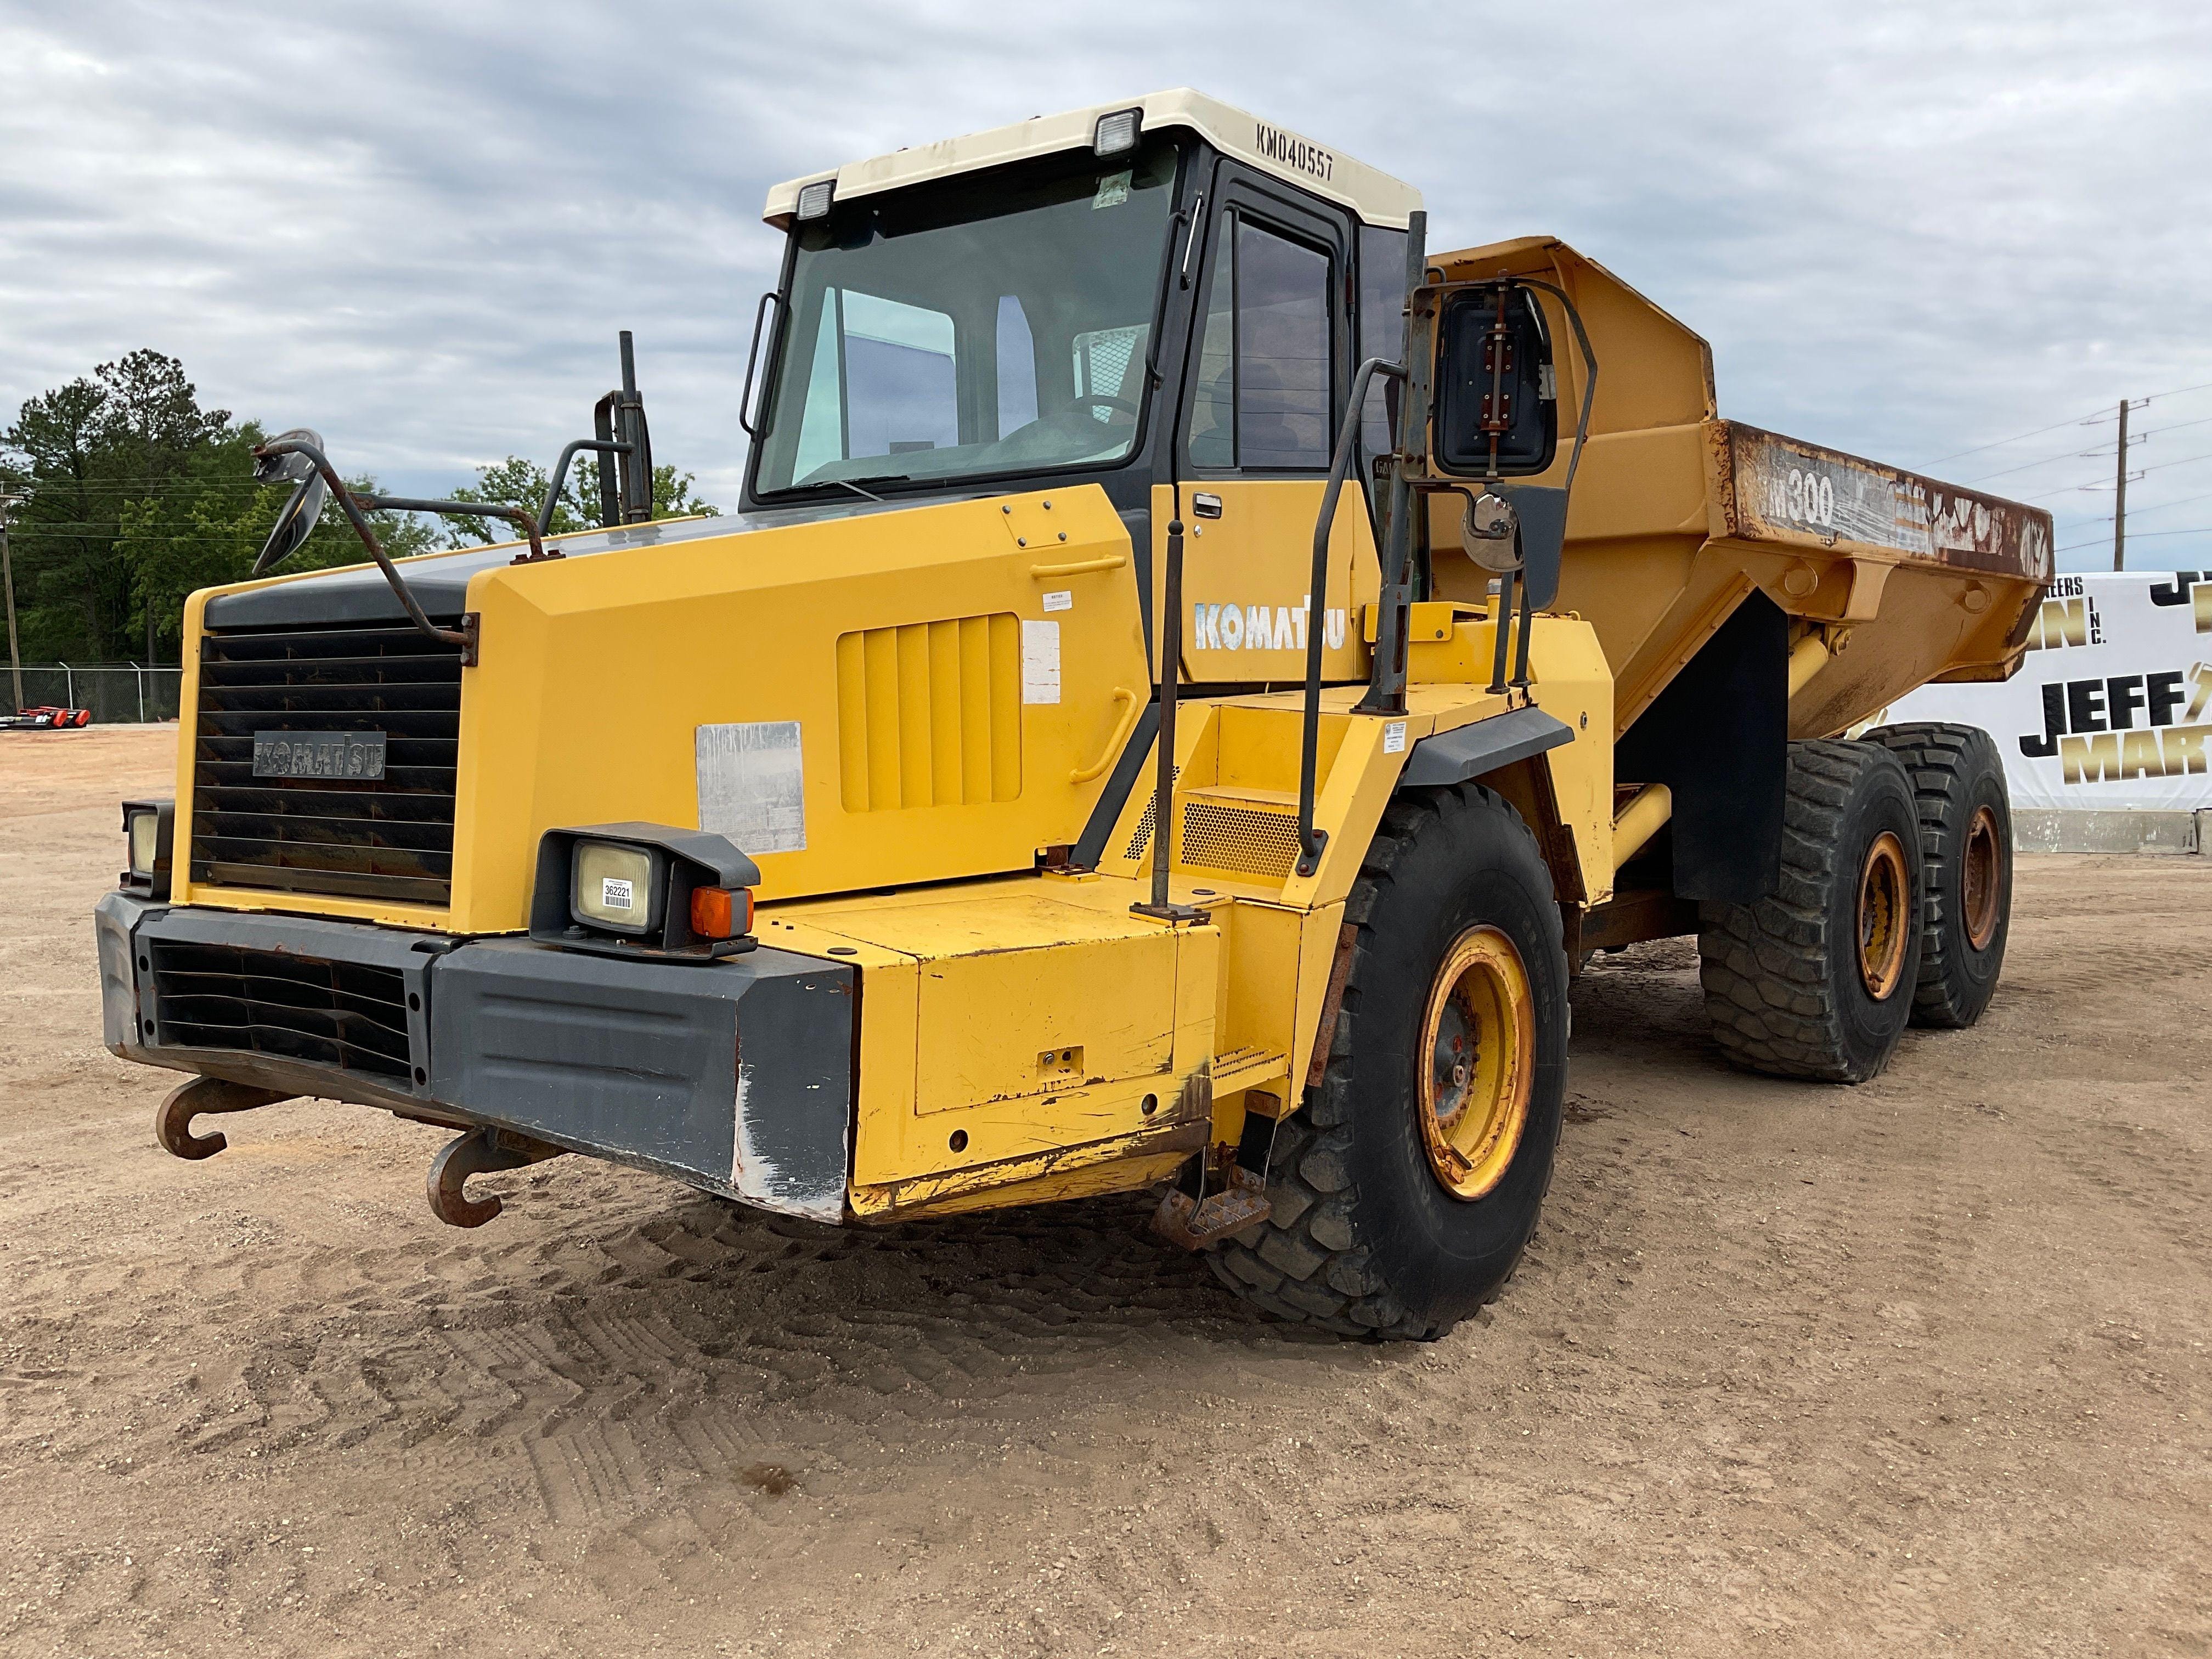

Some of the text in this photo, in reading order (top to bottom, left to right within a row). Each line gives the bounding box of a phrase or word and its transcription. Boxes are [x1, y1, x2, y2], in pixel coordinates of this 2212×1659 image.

[1256, 123, 1333, 182] KM040557
[1194, 595, 1345, 651] KOMATU
[2019, 671, 2185, 757] JEFF
[605, 885, 629, 897] 362221
